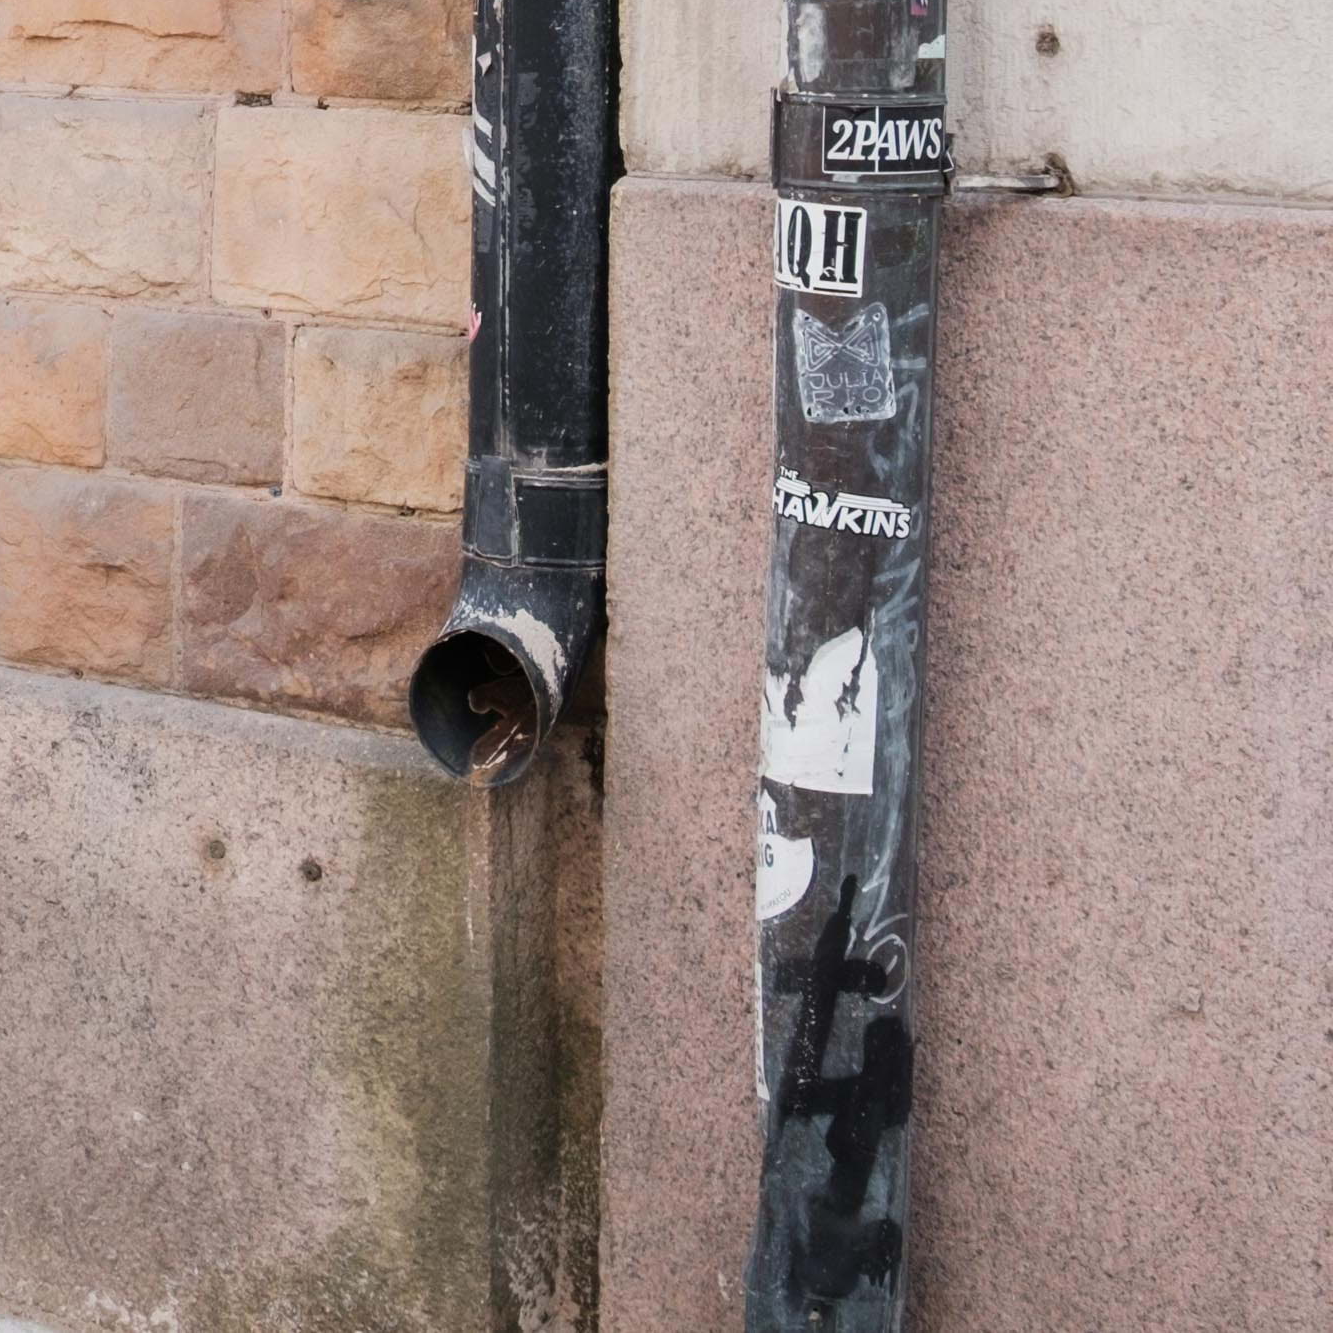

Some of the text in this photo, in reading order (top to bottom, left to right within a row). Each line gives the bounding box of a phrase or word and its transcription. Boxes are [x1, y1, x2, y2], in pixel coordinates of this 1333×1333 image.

[826, 118, 942, 161] 2PAWS
[780, 466, 799, 481] THE
[773, 488, 911, 539] HAWKINS
